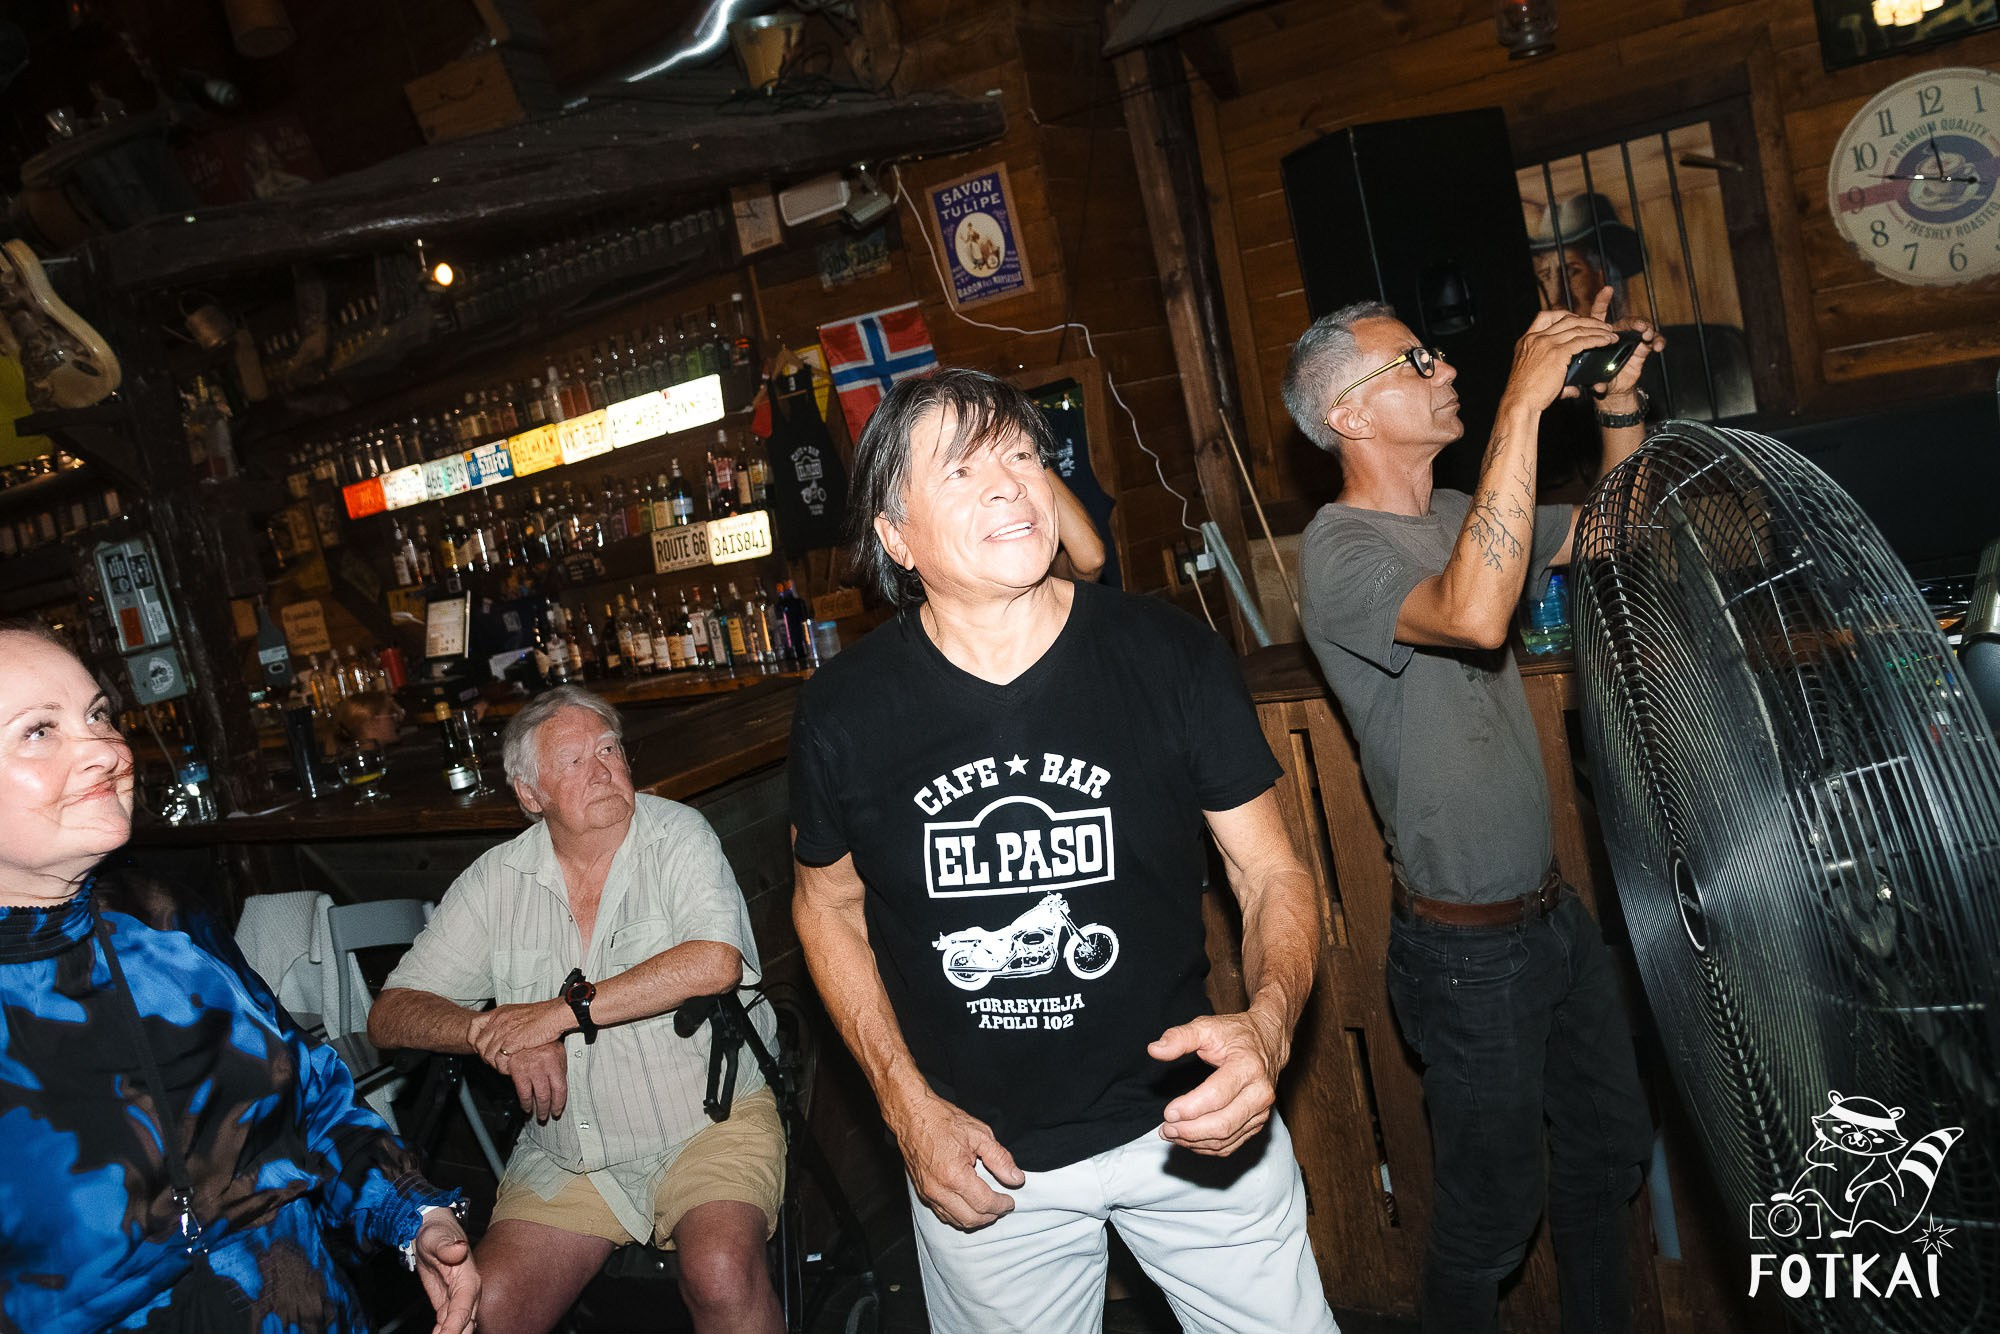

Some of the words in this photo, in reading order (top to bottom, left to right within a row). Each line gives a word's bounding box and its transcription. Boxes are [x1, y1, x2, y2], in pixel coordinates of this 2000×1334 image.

[1916, 86, 1944, 117] 12
[1971, 84, 1987, 114] 1
[1876, 108, 1896, 137] 11
[1889, 120, 1937, 158] PREMIUM
[1940, 116, 1991, 140] QUALITY
[1852, 142, 1878, 171] 10
[941, 179, 993, 206] SAVON
[941, 193, 1001, 220] TULIPE
[1848, 186, 1865, 214] 9
[1870, 220, 1889, 248] 8
[1904, 219, 1951, 240] FRESHLY
[1956, 200, 2000, 238] ROASTED
[1903, 242, 1919, 271] 7
[1948, 242, 1968, 272] 6
[656, 536, 690, 563] ROUTE
[692, 531, 707, 556] 66
[913, 756, 1000, 816] CAFE
[1039, 752, 1111, 799] BAR
[934, 834, 991, 887] EL
[995, 823, 1103, 883] PASO
[966, 992, 1085, 1014] TORREVIEJA
[978, 1014, 1038, 1030] APOLO
[1042, 1013, 1075, 1031] 102
